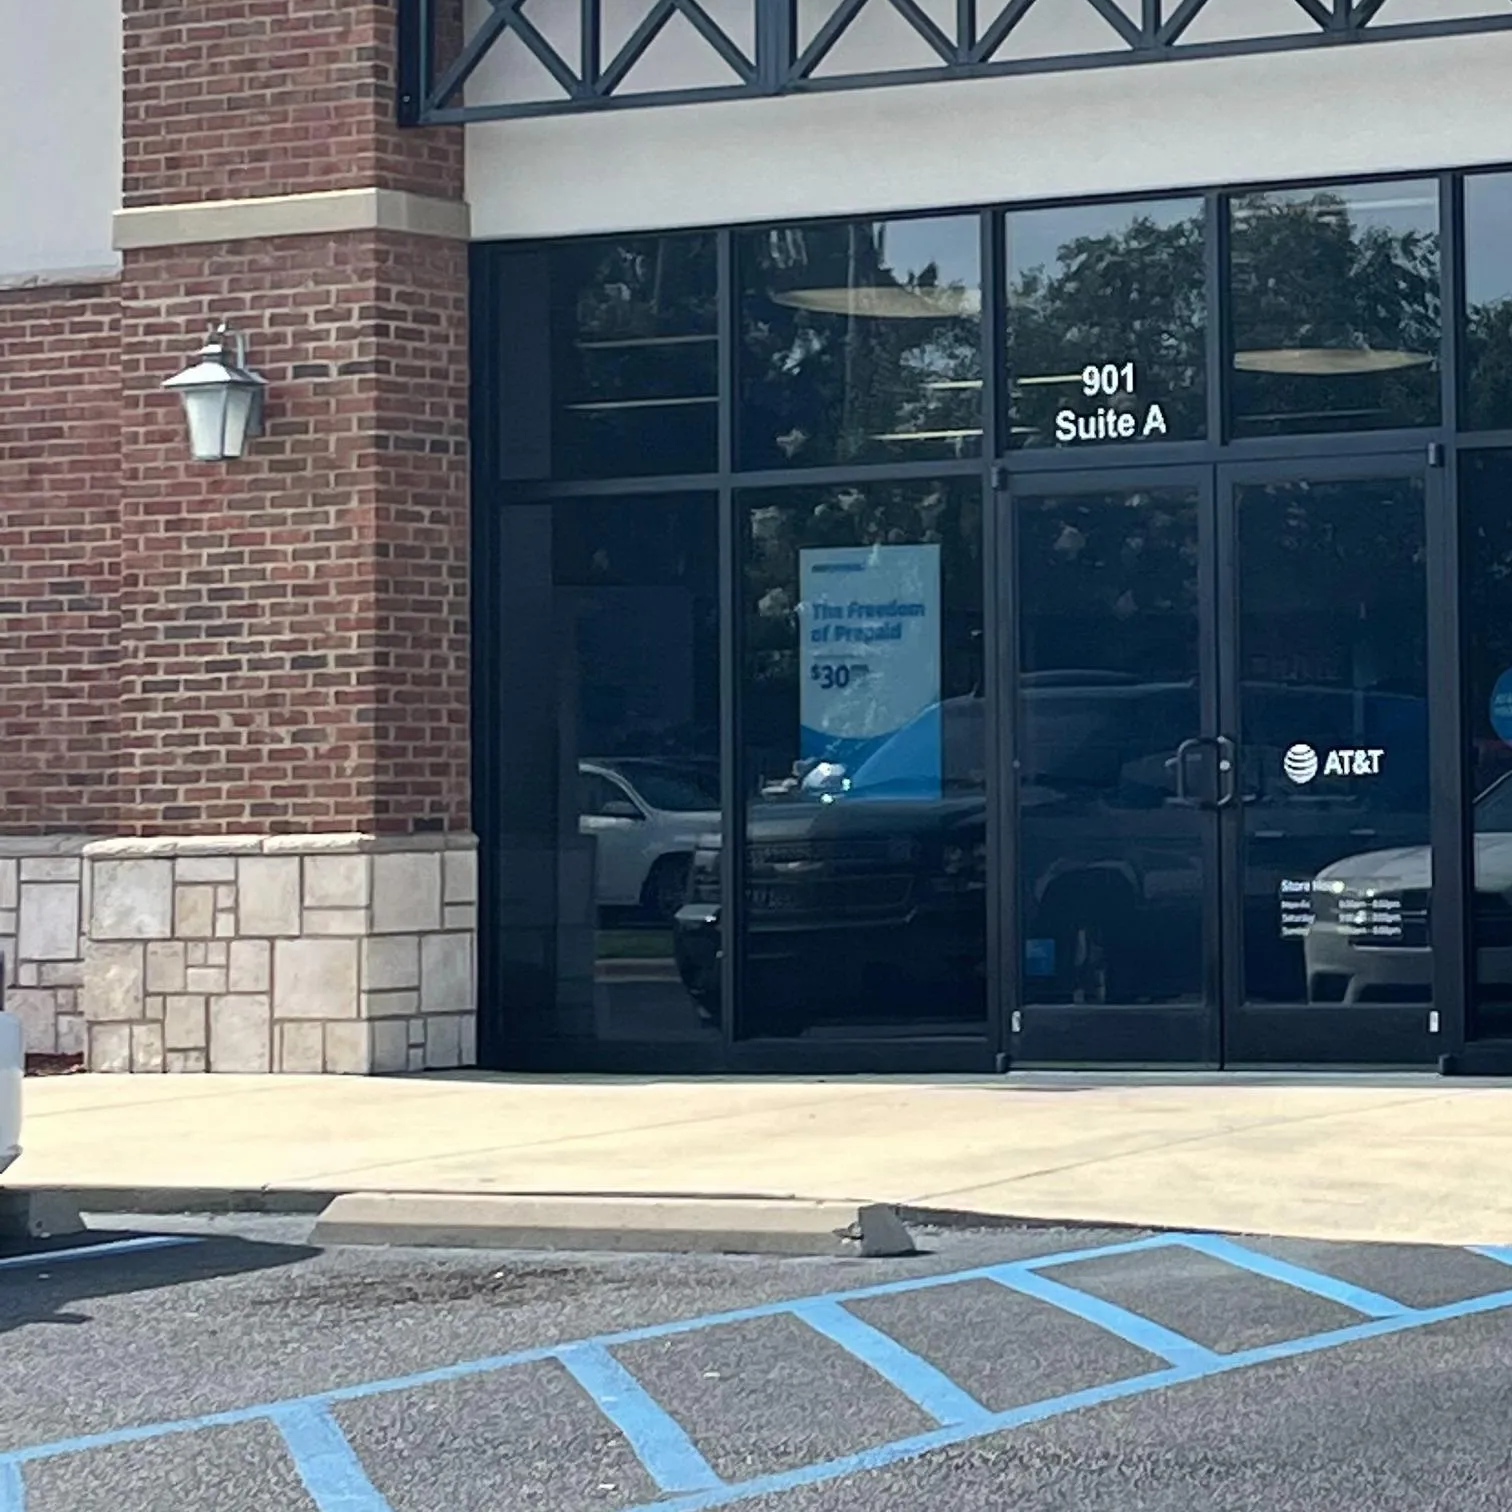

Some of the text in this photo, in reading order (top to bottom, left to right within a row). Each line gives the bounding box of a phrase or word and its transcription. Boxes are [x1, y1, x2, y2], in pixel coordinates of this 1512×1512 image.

[1082, 361, 1134, 396] 901
[1055, 404, 1167, 441] Suite A
[846, 600, 926, 619] Freedom
[1323, 749, 1385, 776] AT&T
